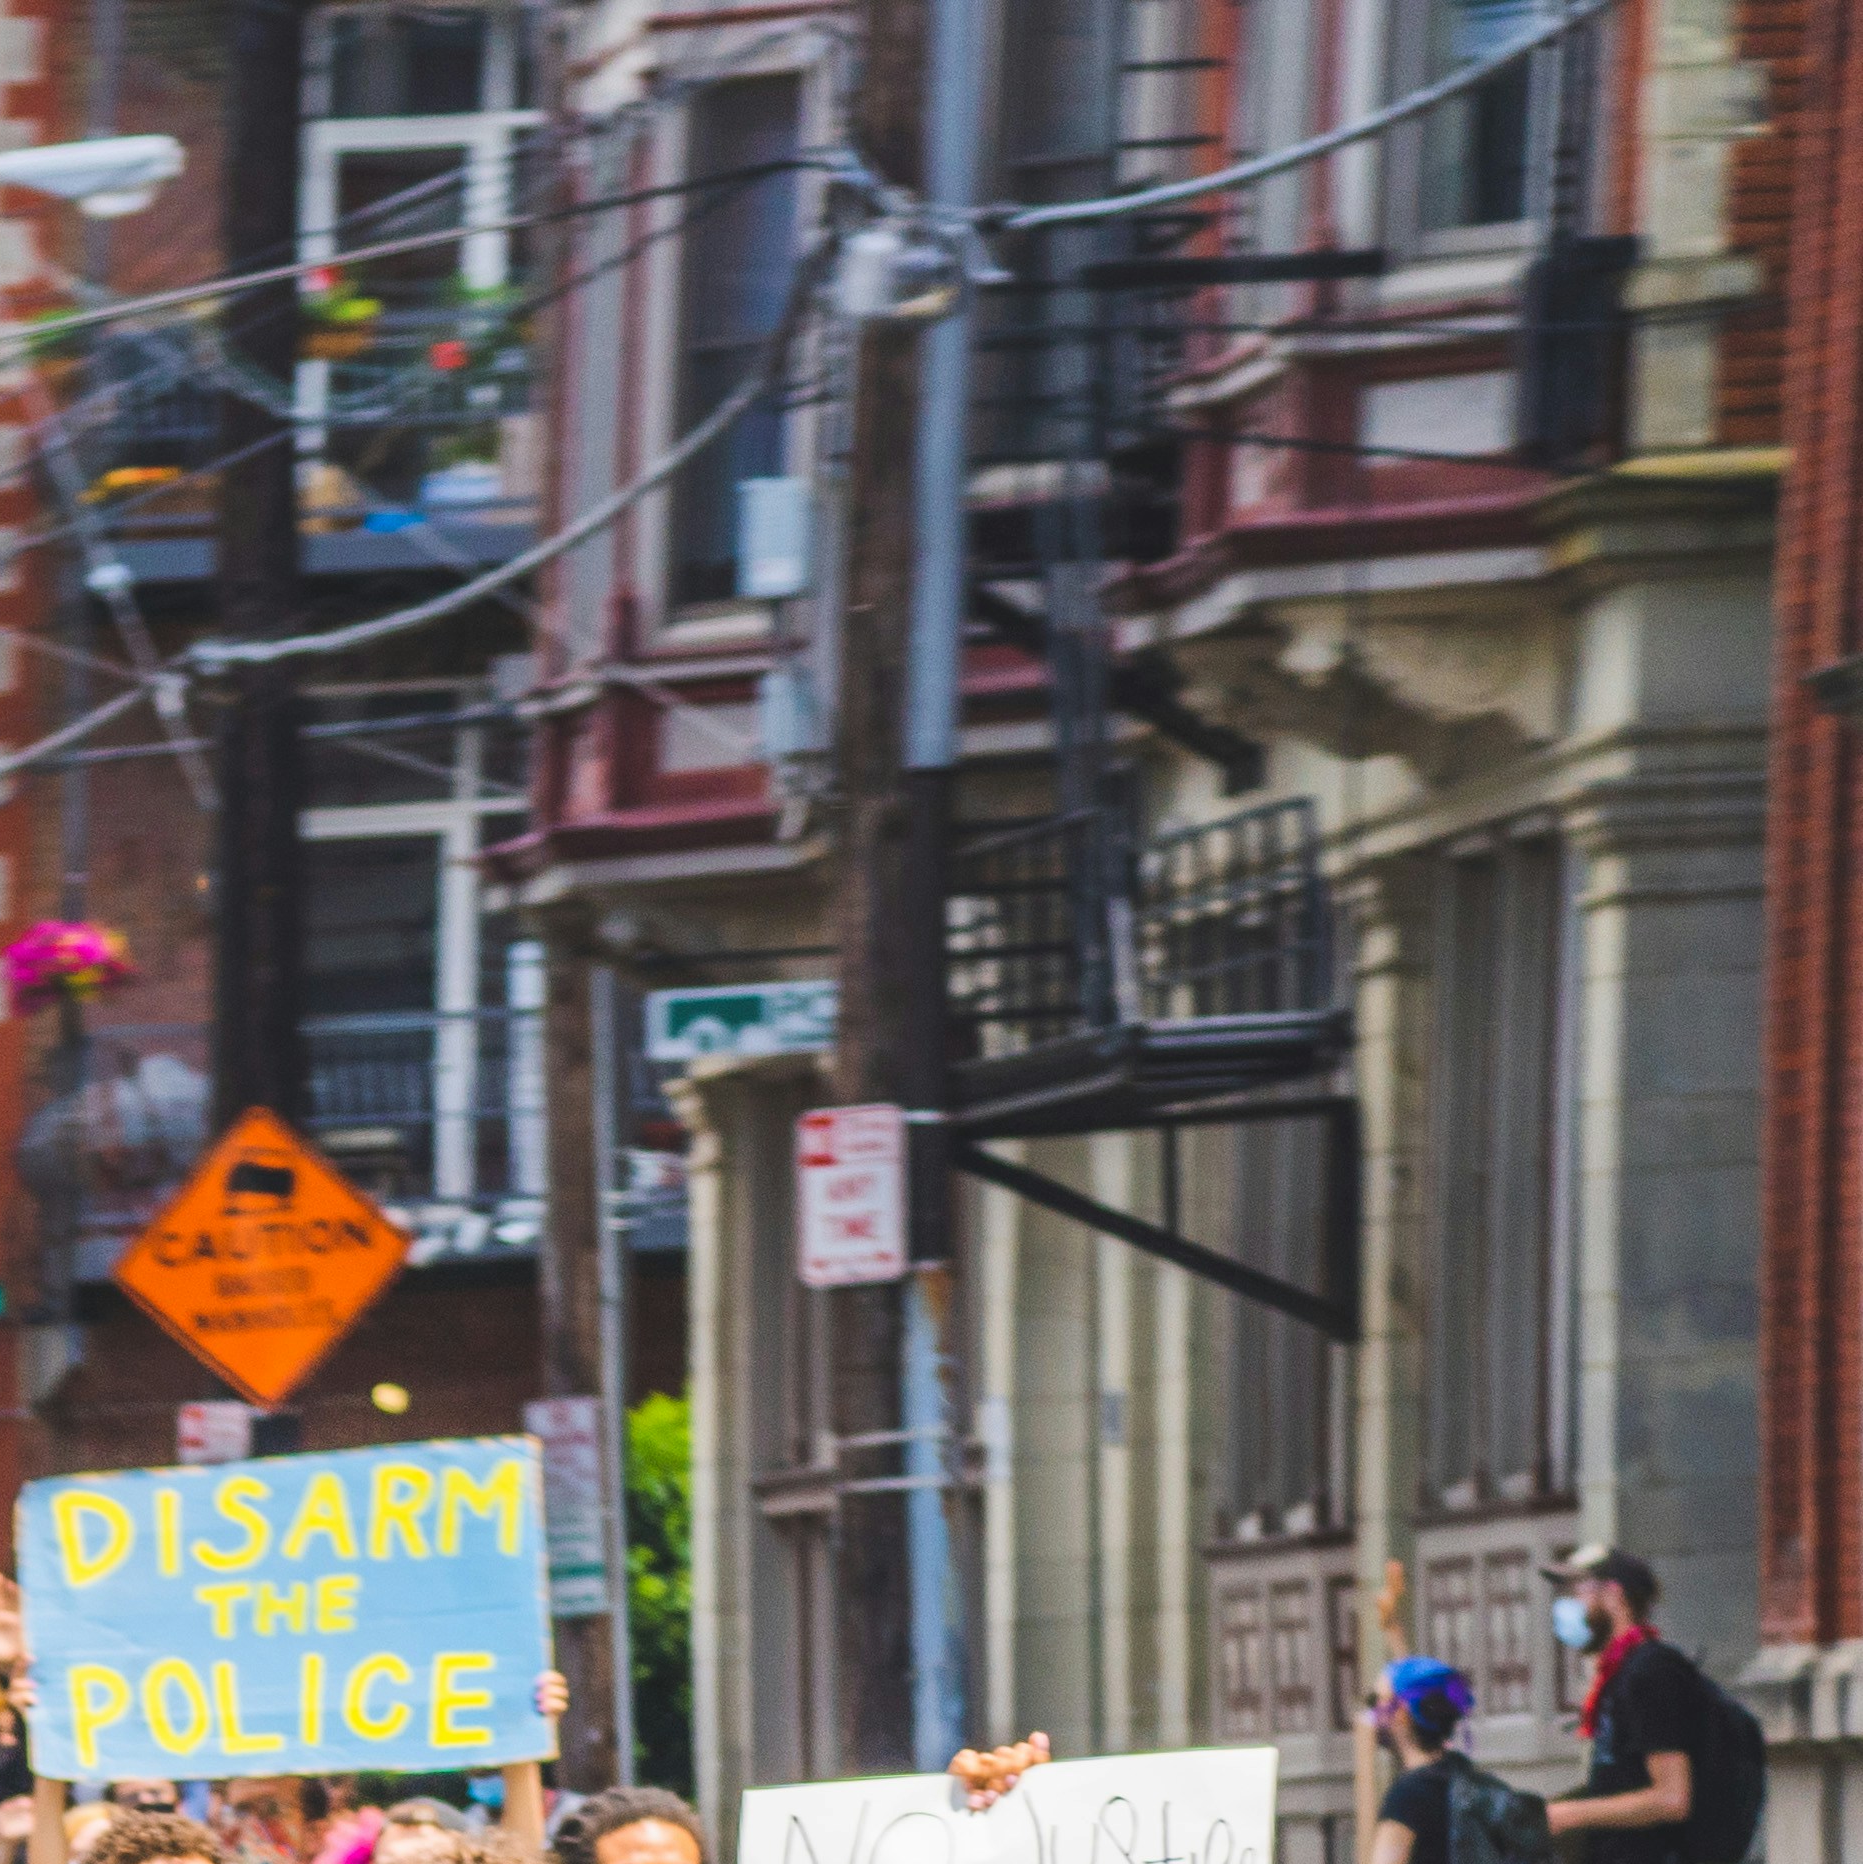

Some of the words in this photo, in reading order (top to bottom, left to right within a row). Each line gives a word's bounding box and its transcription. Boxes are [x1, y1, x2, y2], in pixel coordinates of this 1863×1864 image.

[152, 1217, 372, 1268] CAUTION
[52, 1461, 527, 1587] DISARM
[195, 1574, 362, 1640] THE
[67, 1652, 496, 1767] POLICE
